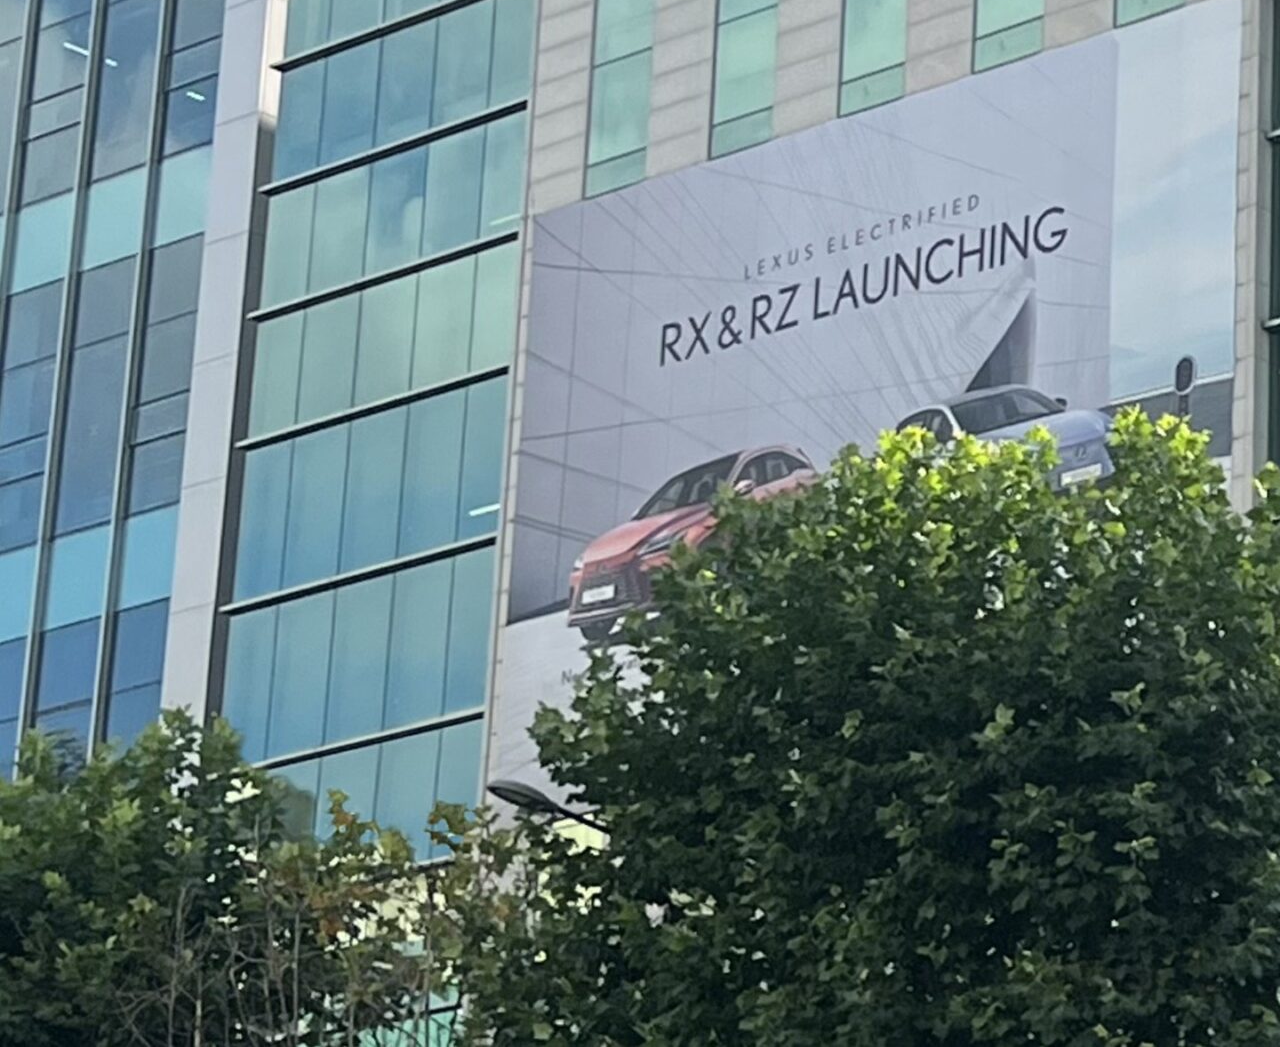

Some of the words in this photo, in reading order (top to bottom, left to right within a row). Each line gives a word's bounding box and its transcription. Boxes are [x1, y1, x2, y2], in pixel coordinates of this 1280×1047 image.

[659, 283, 803, 367] RX&RZ
[812, 206, 1069, 321] LAUNCHING
[743, 243, 814, 281] LEXUS
[826, 193, 981, 255] ELECTRIFIED
